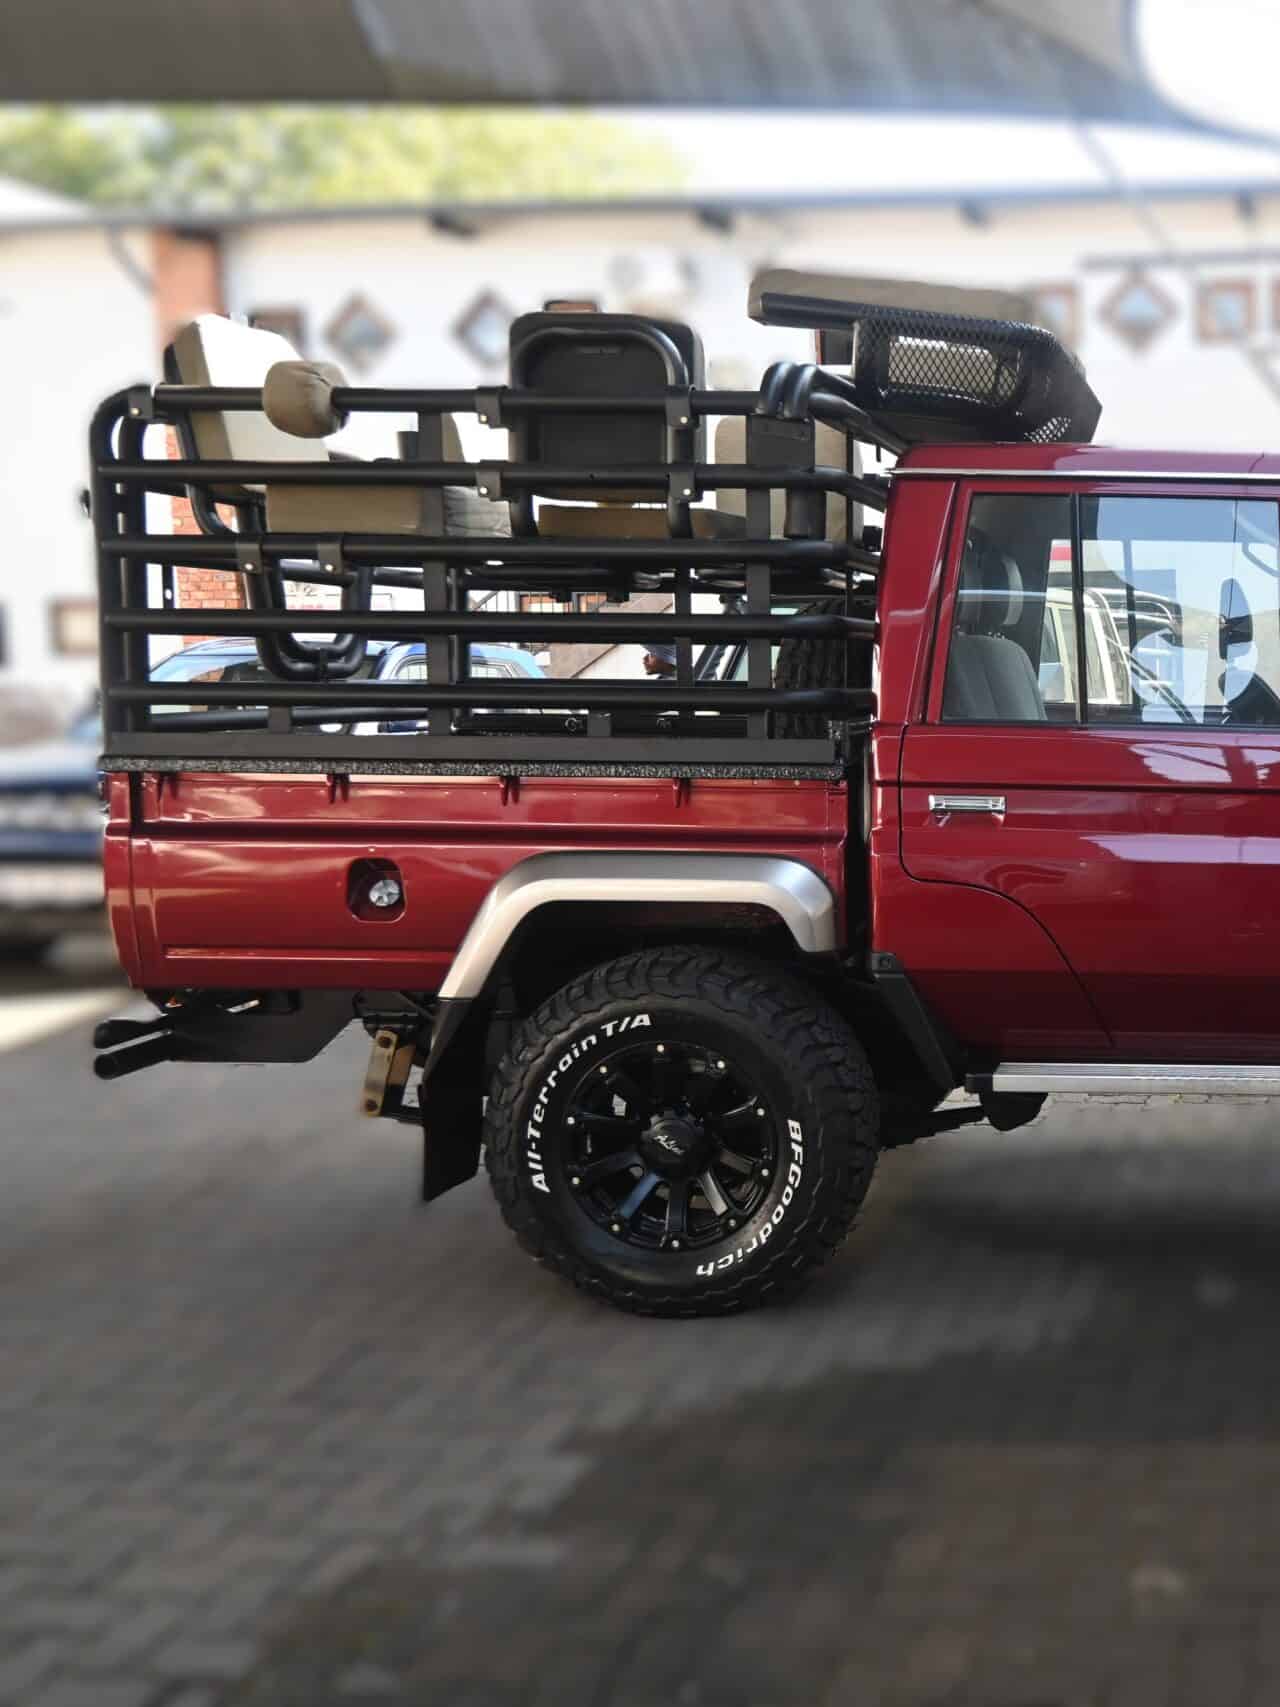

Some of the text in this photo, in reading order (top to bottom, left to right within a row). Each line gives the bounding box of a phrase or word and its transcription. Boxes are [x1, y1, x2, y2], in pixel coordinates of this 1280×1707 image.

[526, 1013, 652, 1193] All-Terrain T/A
[695, 1118, 804, 1277] BFGoodrich
